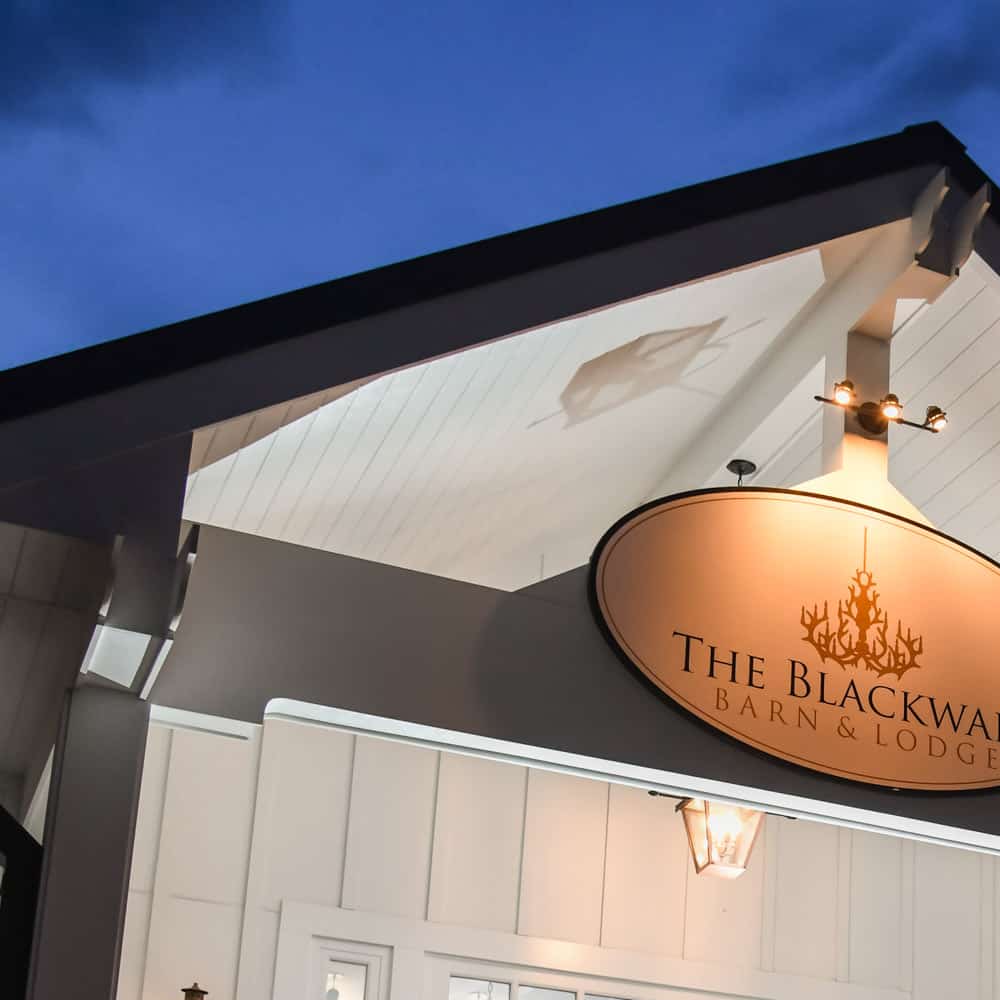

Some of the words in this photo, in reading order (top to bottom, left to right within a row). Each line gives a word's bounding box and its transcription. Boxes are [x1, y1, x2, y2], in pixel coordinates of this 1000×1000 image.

[672, 631, 766, 690] THE
[714, 687, 819, 730] BARN
[836, 715, 857, 741] &
[875, 727, 1000, 771] LODGE
